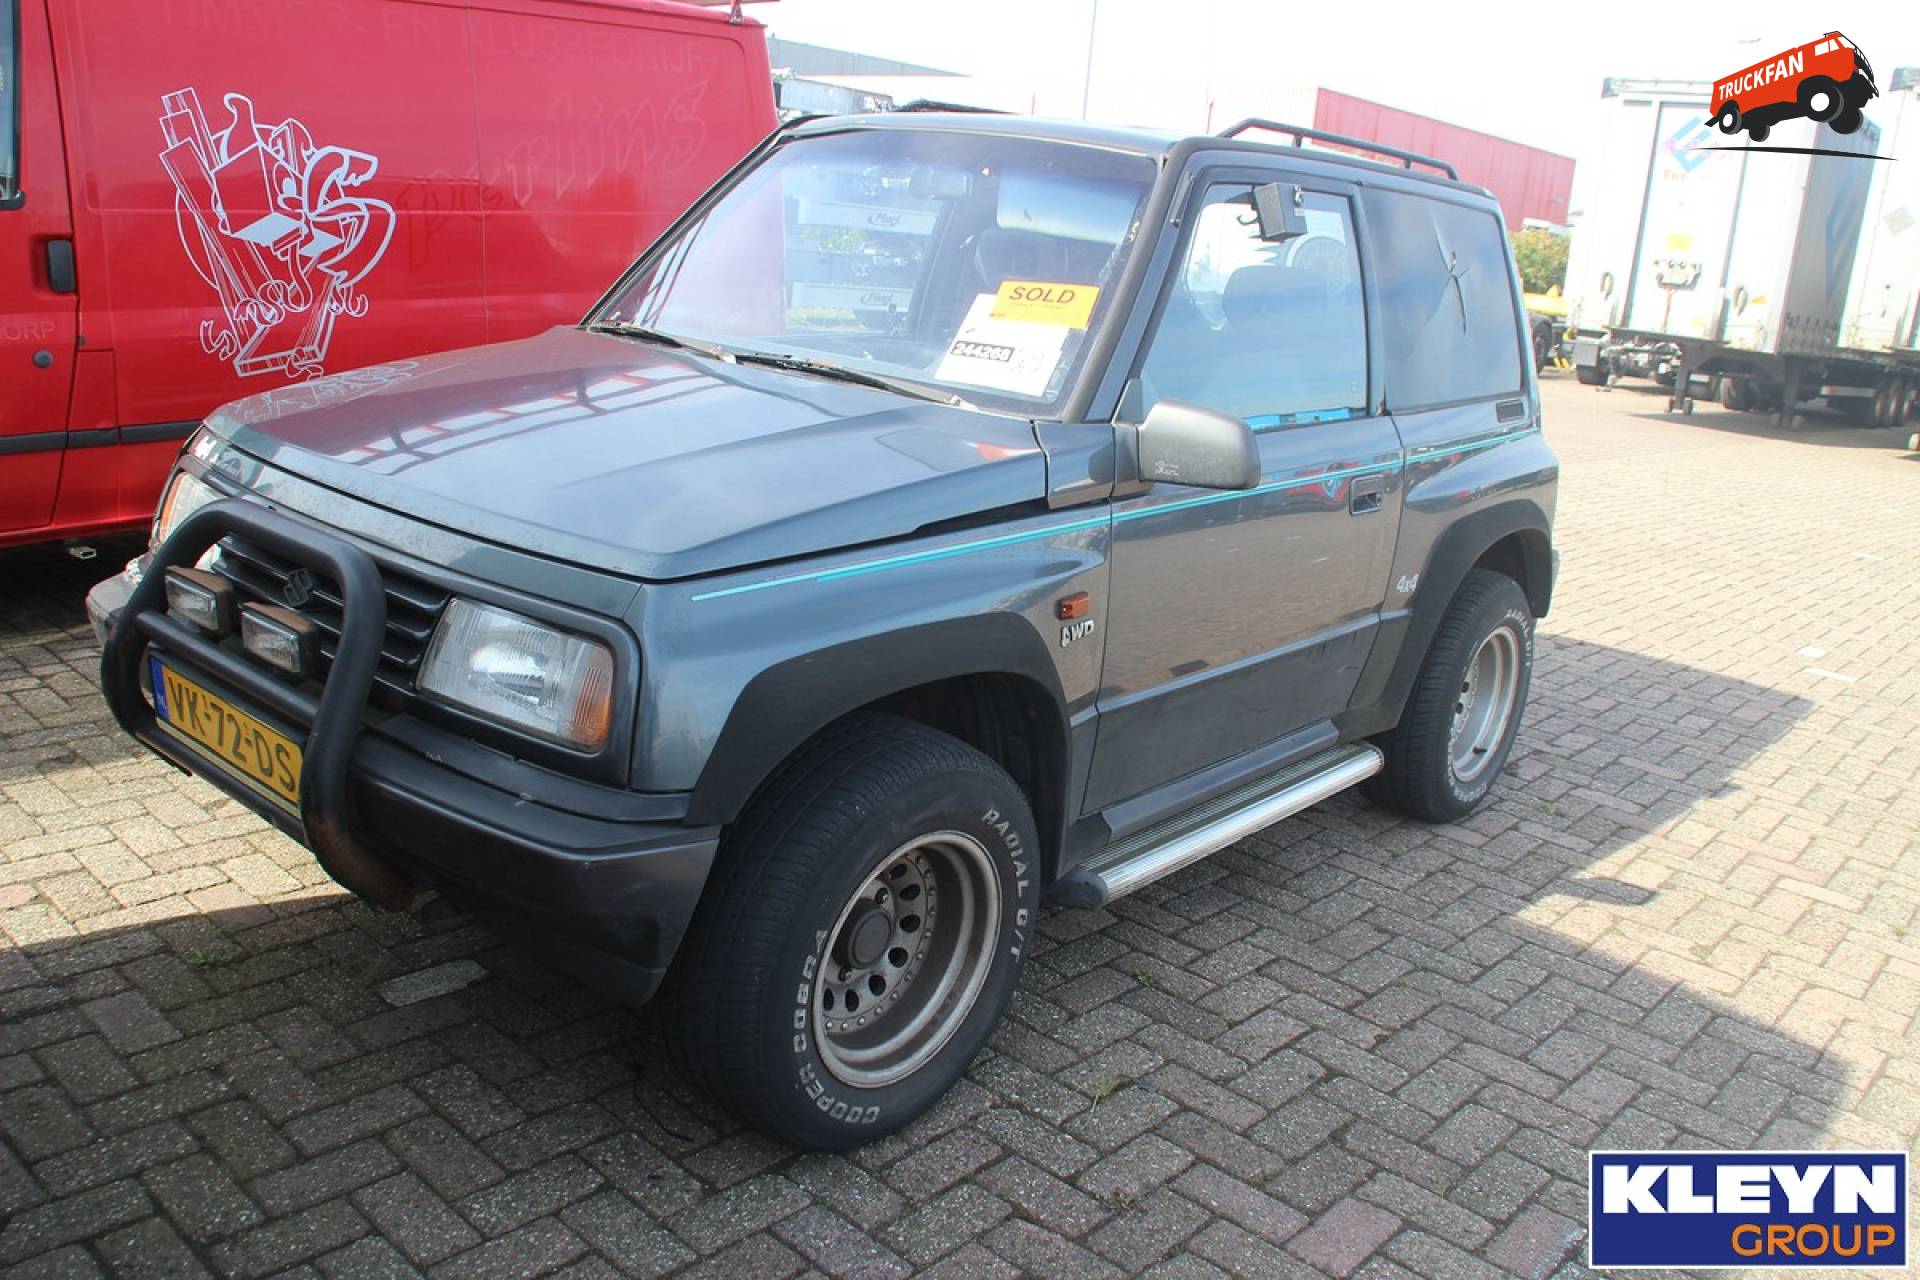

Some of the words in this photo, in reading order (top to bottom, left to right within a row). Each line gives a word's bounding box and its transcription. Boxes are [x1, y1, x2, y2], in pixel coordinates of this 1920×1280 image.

[1009, 286, 1076, 304] SOLD
[167, 676, 297, 793] VK-72-DS
[980, 807, 1030, 899] RADIAL
[793, 930, 828, 1053] COBRA
[799, 1062, 881, 1125] COOPER
